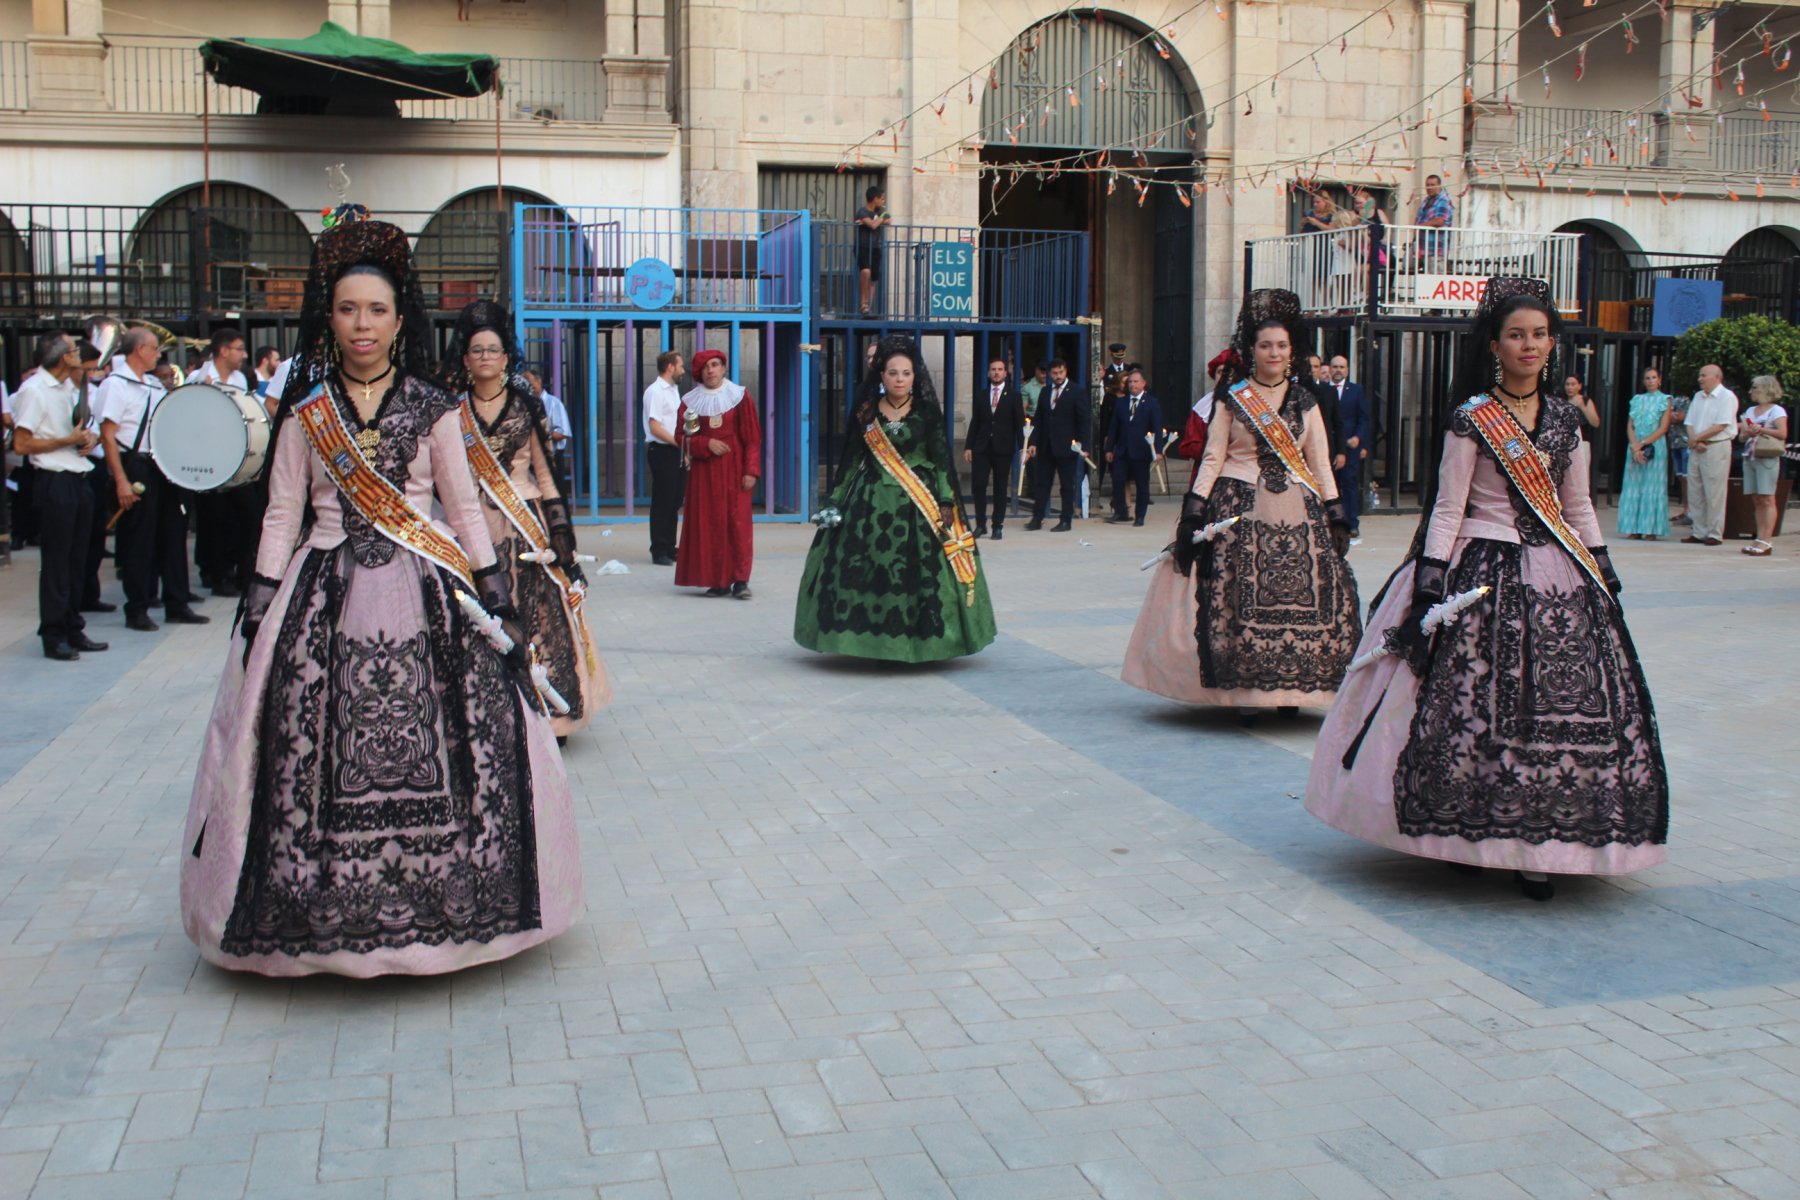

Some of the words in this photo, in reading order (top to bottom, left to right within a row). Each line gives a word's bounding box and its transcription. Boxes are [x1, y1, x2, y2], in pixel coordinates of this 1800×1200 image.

[935, 249, 967, 265] ELS
[932, 271, 966, 288] QUE
[1417, 279, 1488, 303] ...ARRE
[932, 292, 972, 312] SOM
